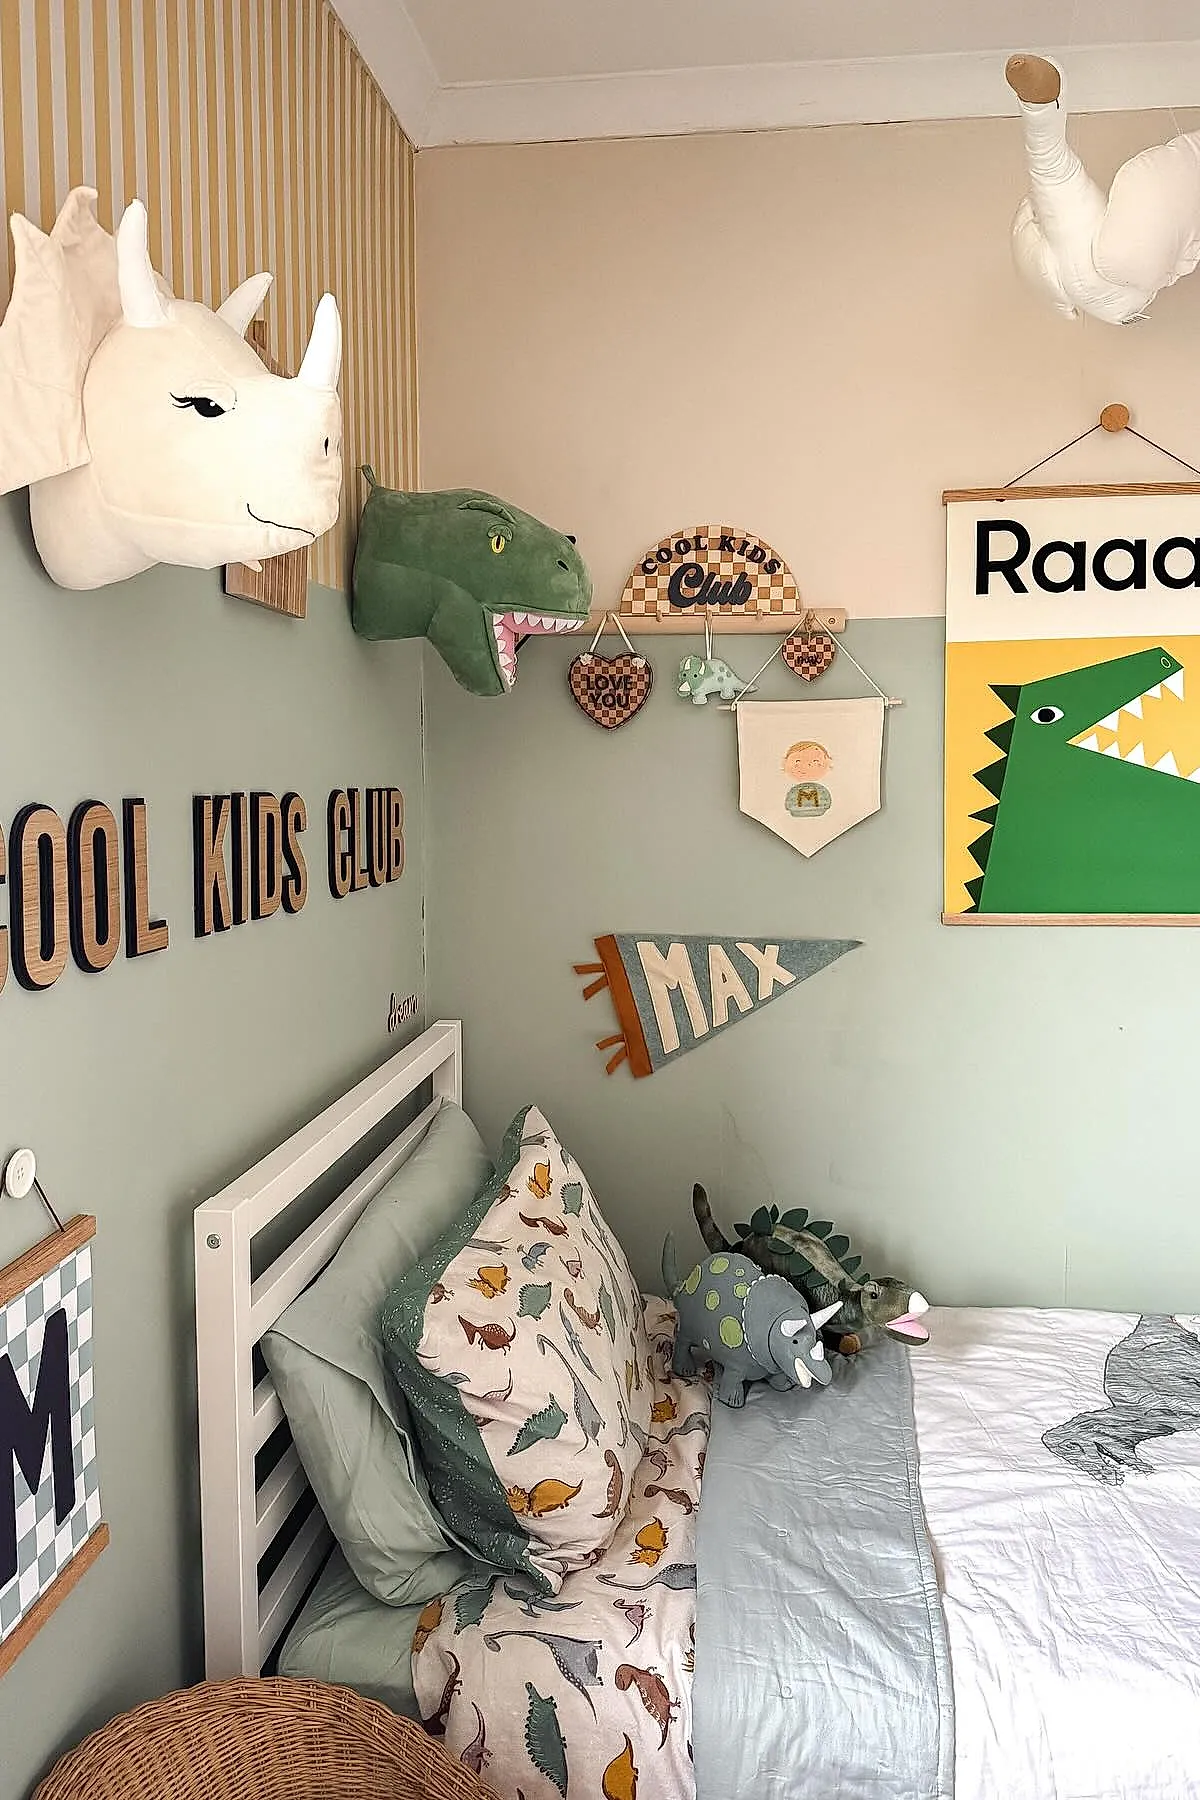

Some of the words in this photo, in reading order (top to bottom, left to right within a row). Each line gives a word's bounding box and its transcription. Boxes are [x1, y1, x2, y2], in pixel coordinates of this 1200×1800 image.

[641, 534, 708, 575] COOL
[718, 534, 781, 574] KIDS
[668, 562, 753, 608] Club
[586, 673, 633, 690] LOVE
[588, 692, 630, 708] YOU
[797, 788, 819, 807] M
[0, 797, 169, 993] OOL
[192, 790, 309, 938] KIDS
[327, 787, 406, 899] CLUB
[636, 941, 797, 1055] MAX
